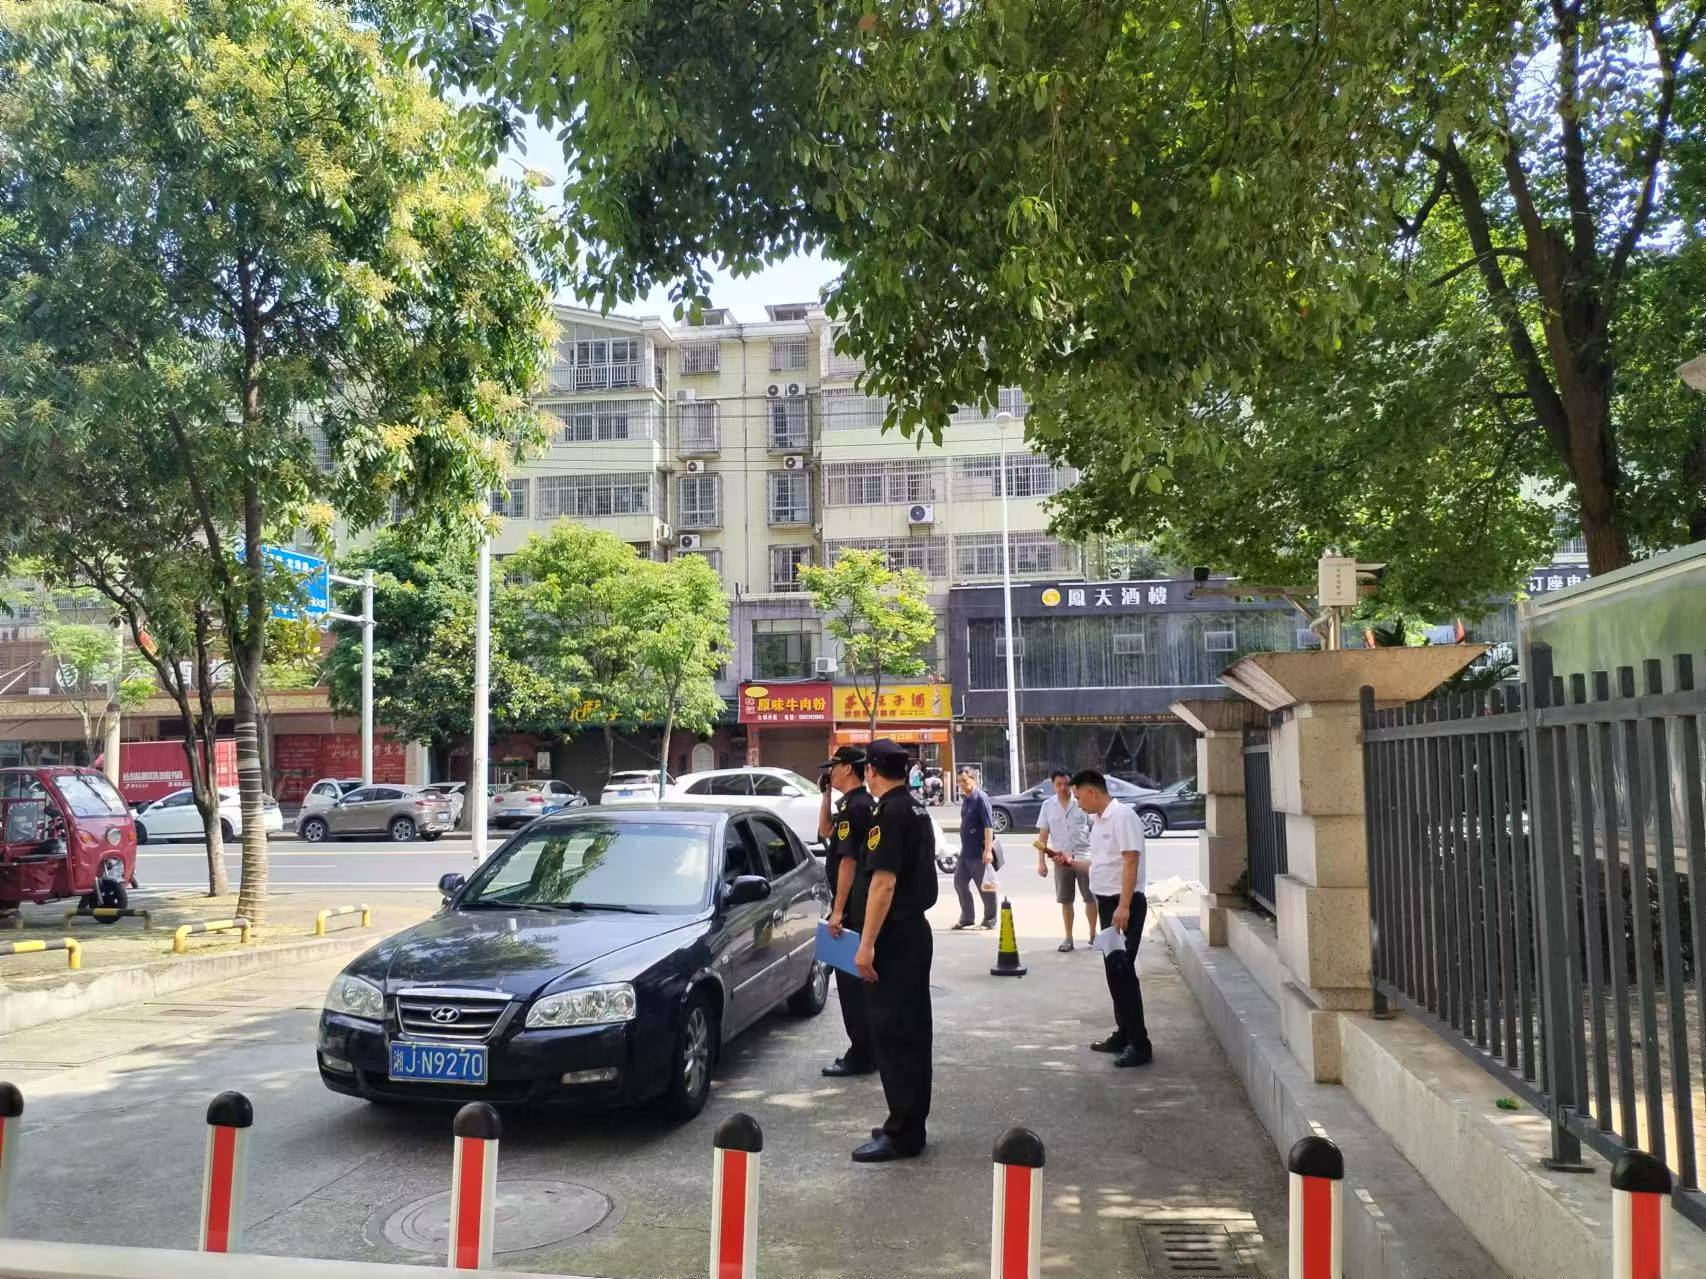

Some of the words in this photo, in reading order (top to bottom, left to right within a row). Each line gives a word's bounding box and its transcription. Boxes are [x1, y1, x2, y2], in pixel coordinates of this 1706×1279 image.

[1528, 574, 1591, 592] 订座电
[757, 697, 826, 711] 原味牛肉粉
